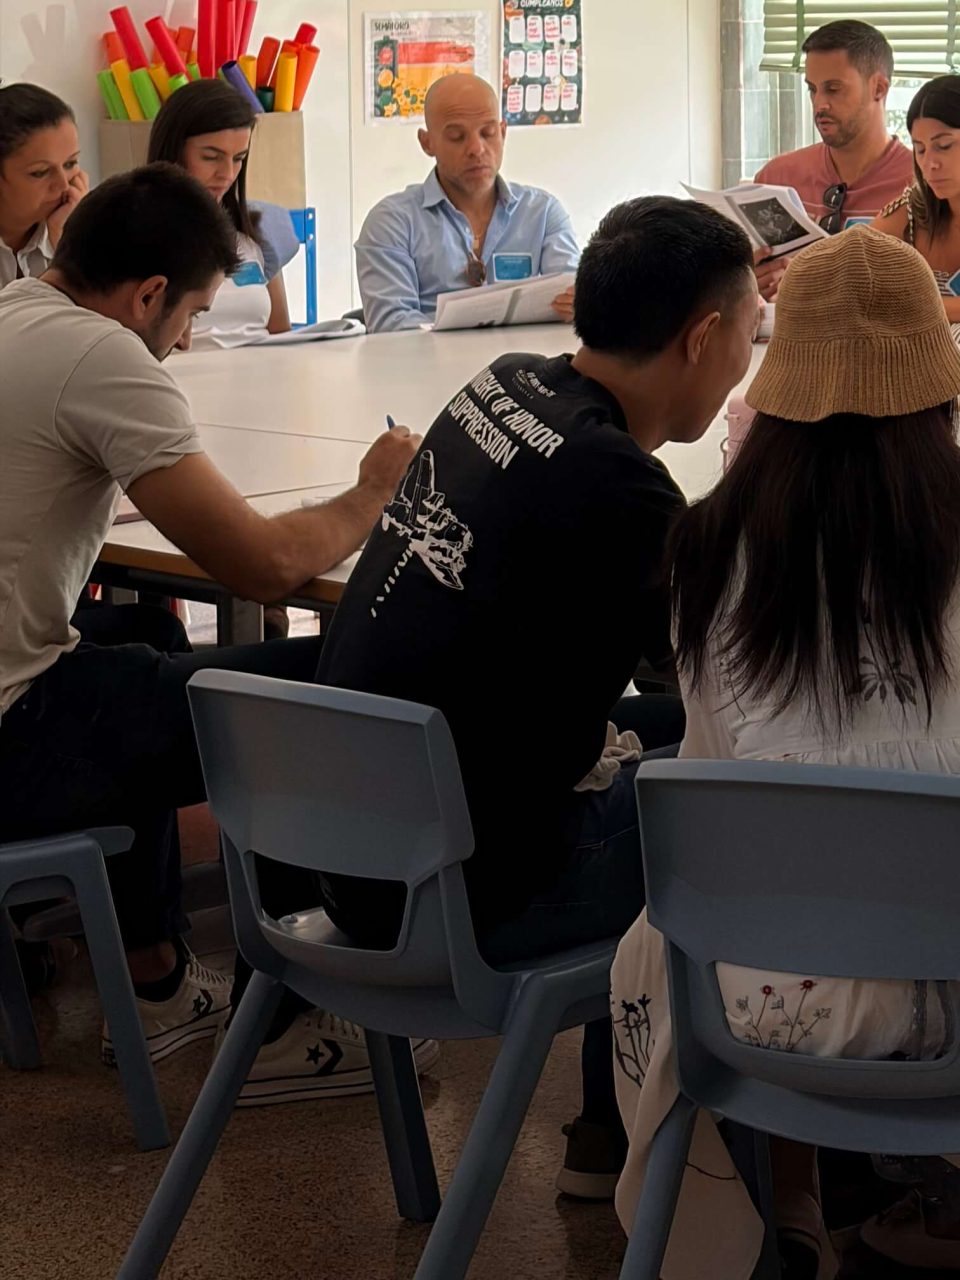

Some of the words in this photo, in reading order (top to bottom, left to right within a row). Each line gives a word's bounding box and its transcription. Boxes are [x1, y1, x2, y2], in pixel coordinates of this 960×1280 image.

[448, 391, 520, 470] SUPPRESSION
[491, 396, 520, 415] OF
[502, 408, 565, 459] HONOR
